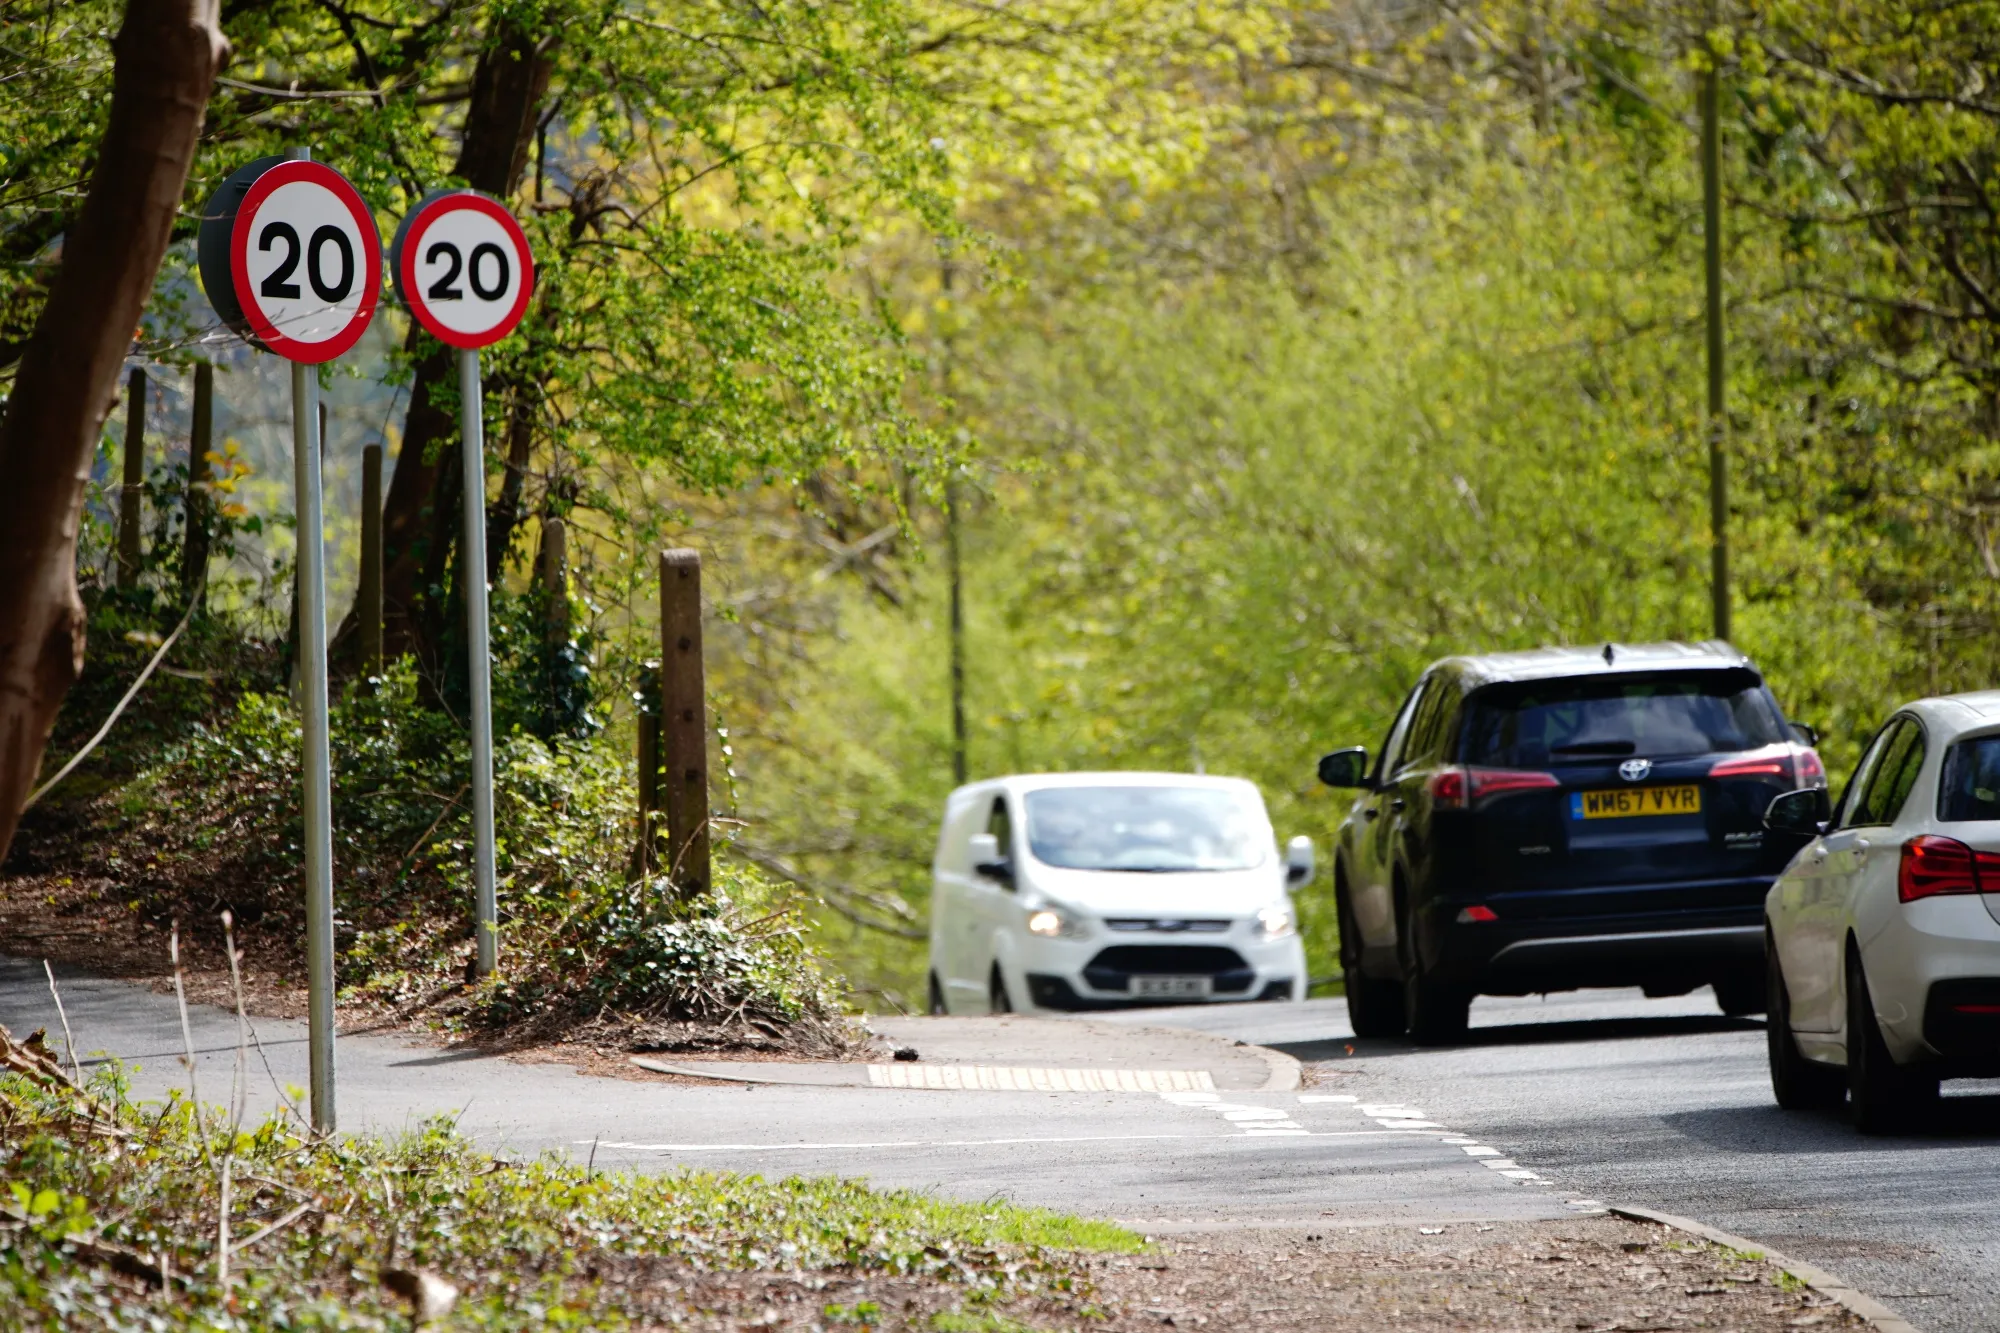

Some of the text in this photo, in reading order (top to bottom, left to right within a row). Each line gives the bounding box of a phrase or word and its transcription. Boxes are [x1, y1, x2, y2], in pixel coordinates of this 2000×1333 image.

[258, 221, 355, 303] 20
[425, 242, 510, 301] 20
[1587, 787, 1695, 813] WM67 VYR
